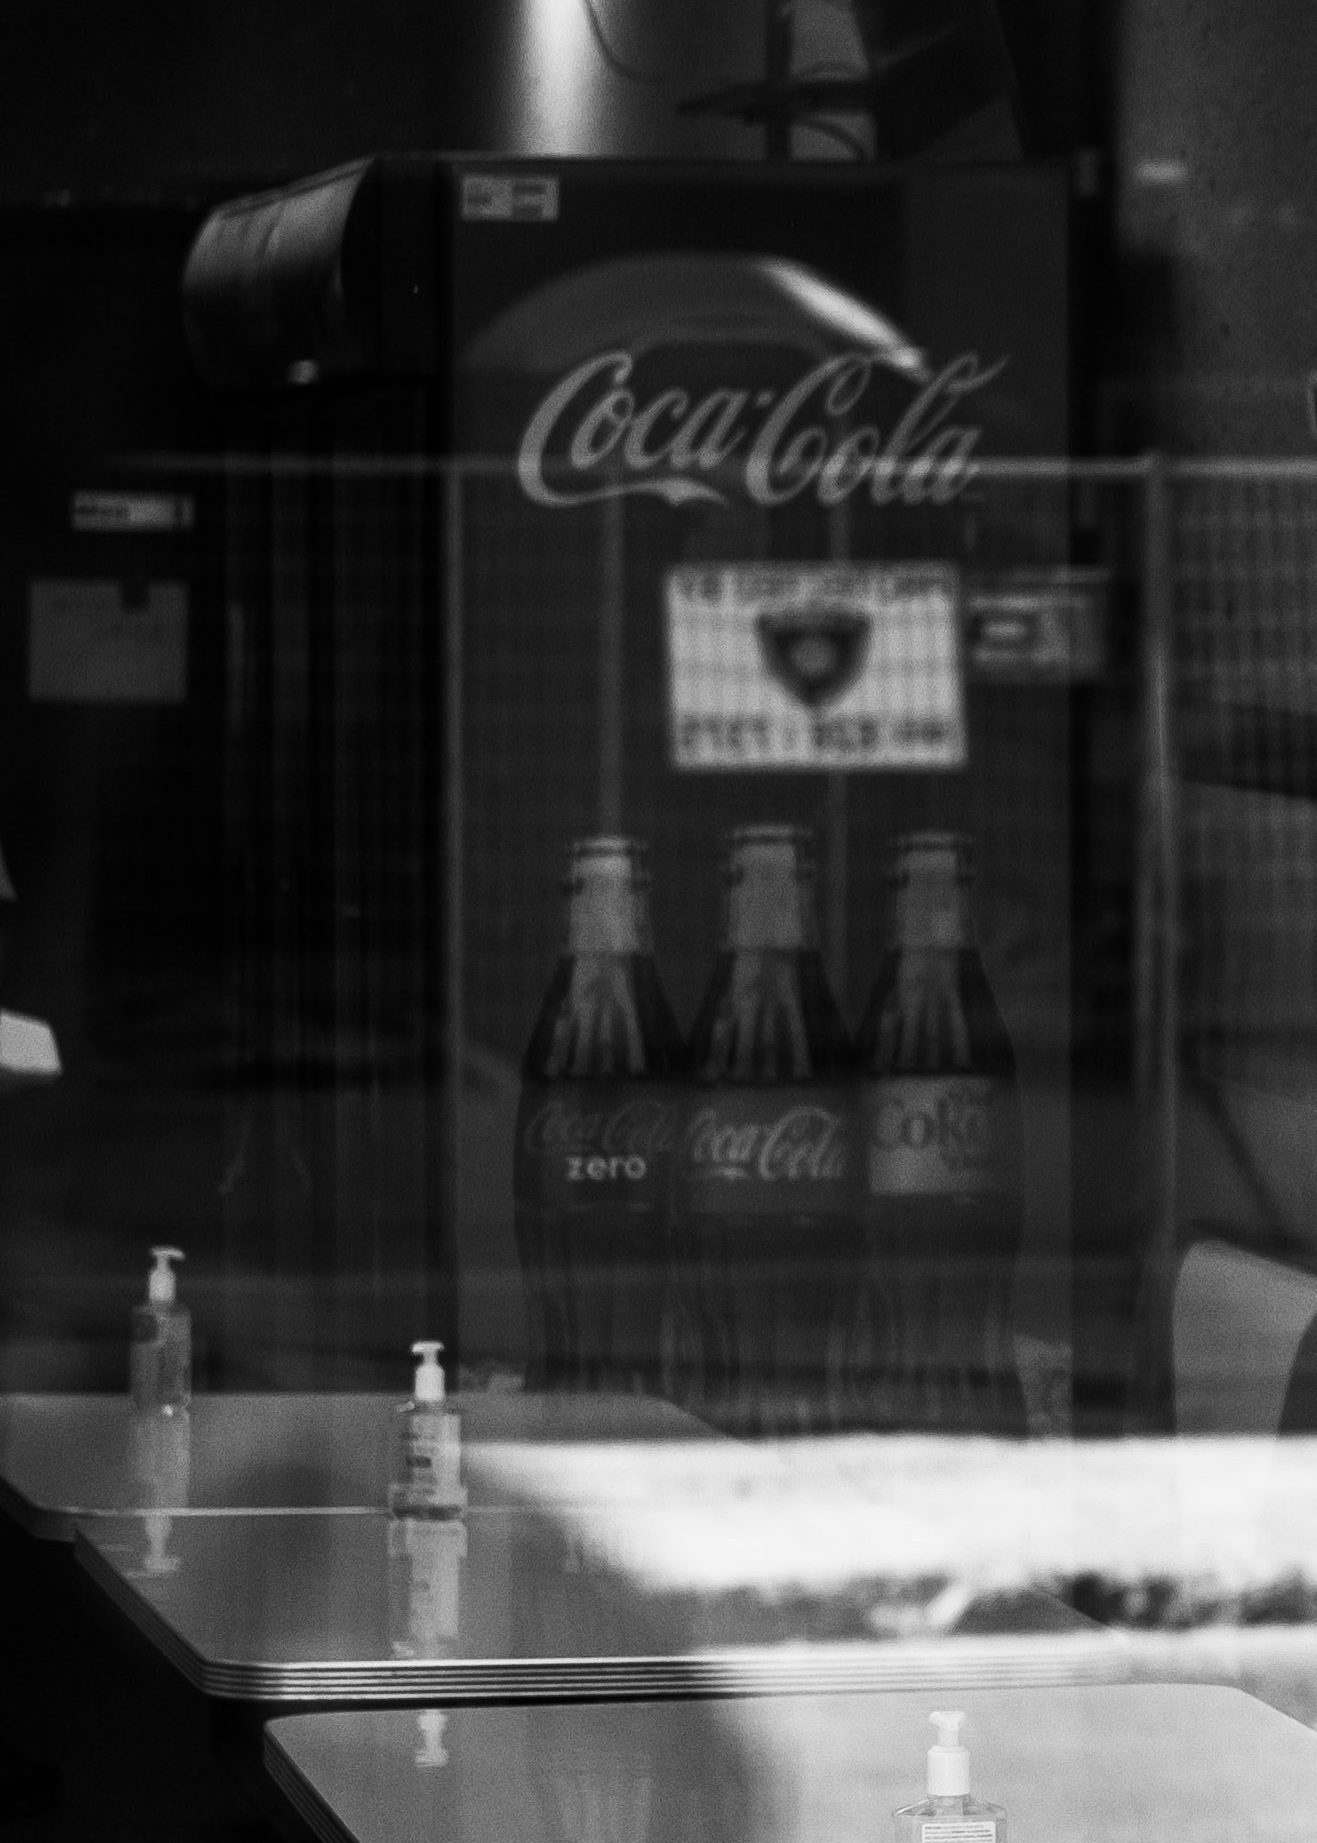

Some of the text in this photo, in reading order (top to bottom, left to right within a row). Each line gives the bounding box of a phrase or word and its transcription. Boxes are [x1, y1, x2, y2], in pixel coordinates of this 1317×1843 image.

[515, 352, 1008, 508] Coca-Cola
[565, 1154, 648, 1182] zero
[687, 1104, 846, 1182] Coca-Cola
